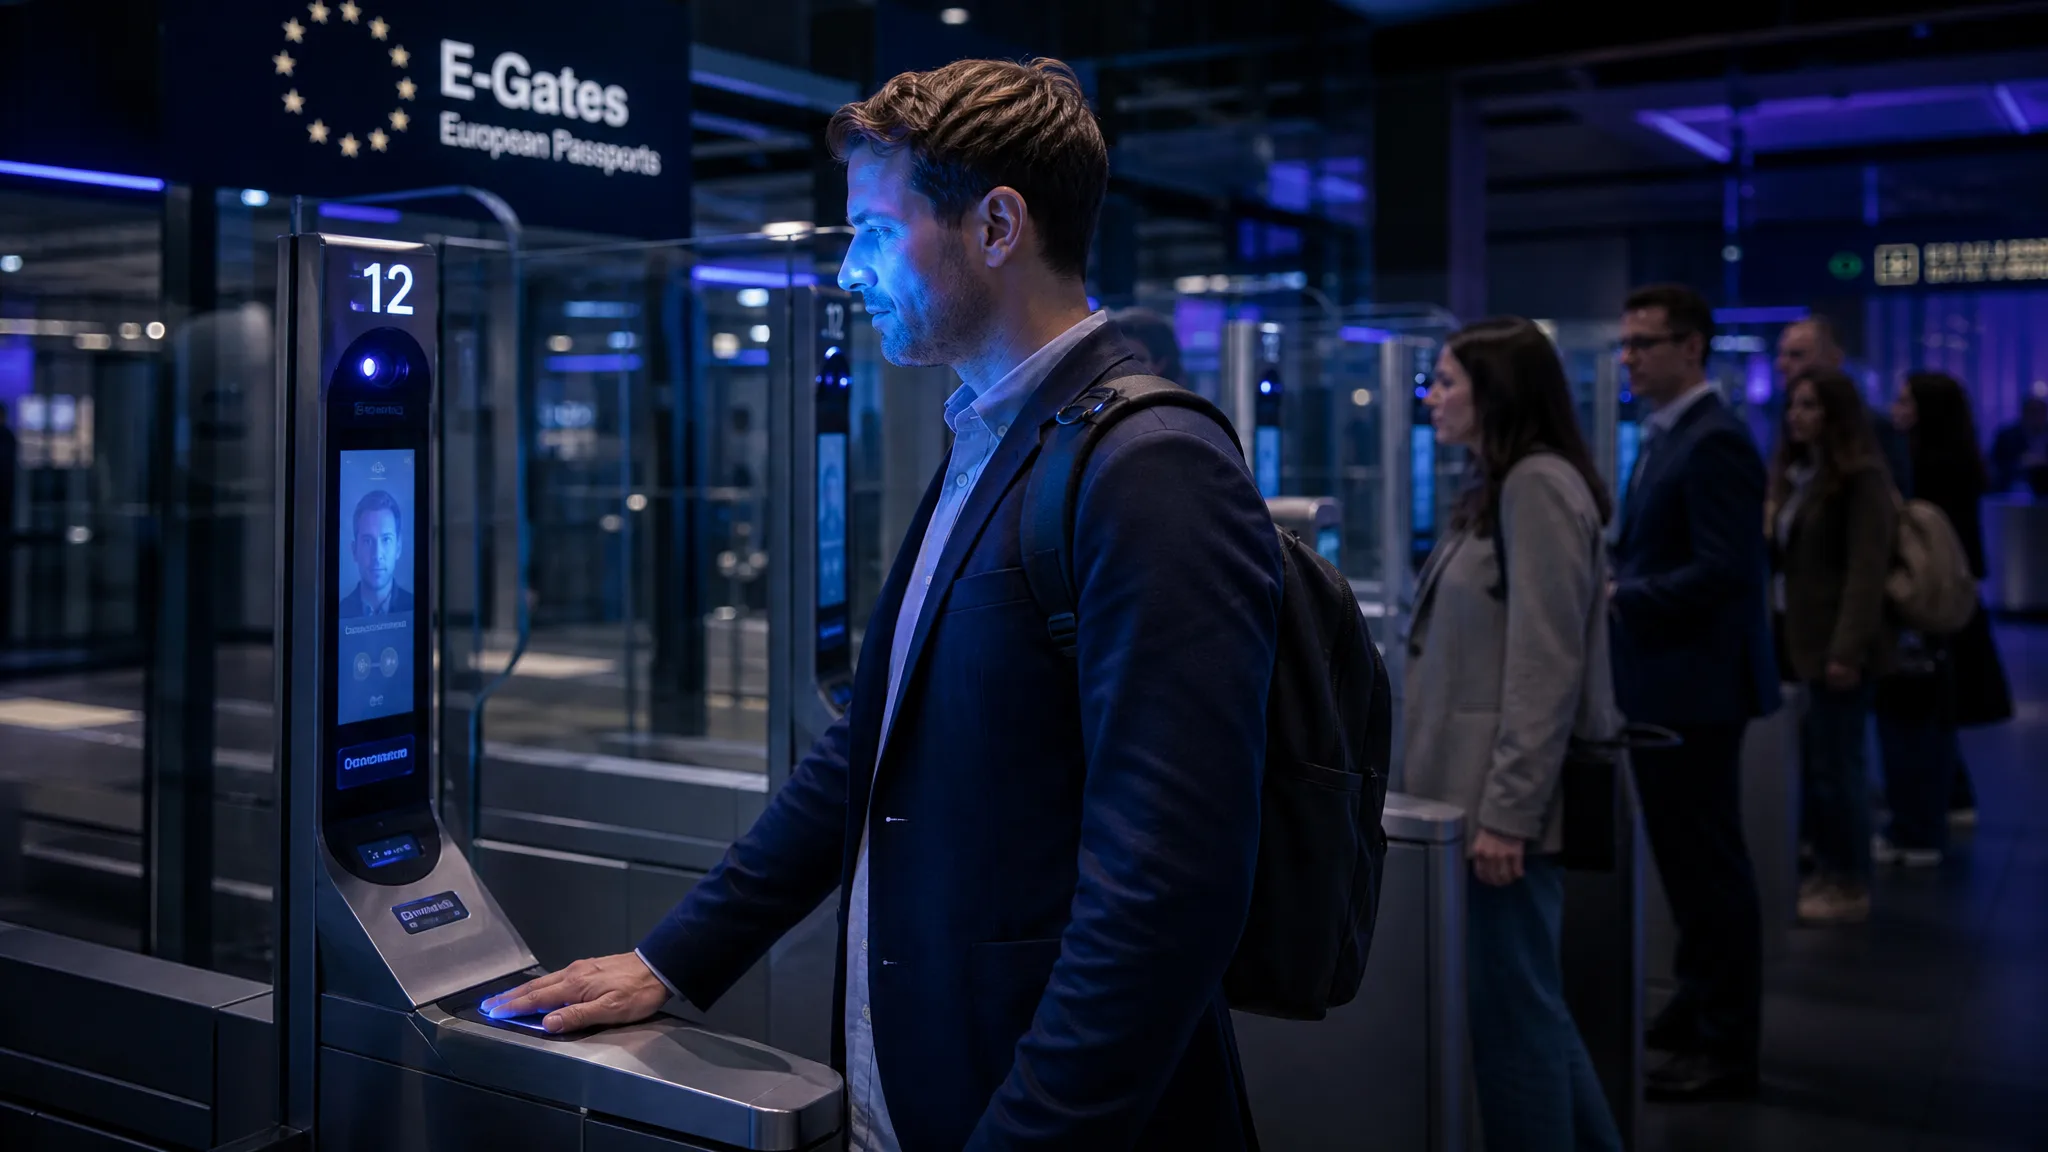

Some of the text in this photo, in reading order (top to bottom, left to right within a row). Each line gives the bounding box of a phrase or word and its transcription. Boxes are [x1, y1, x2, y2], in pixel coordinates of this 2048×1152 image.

[441, 38, 629, 127] E-Gates
[440, 110, 661, 176] European Passports
[363, 262, 414, 315] 12
